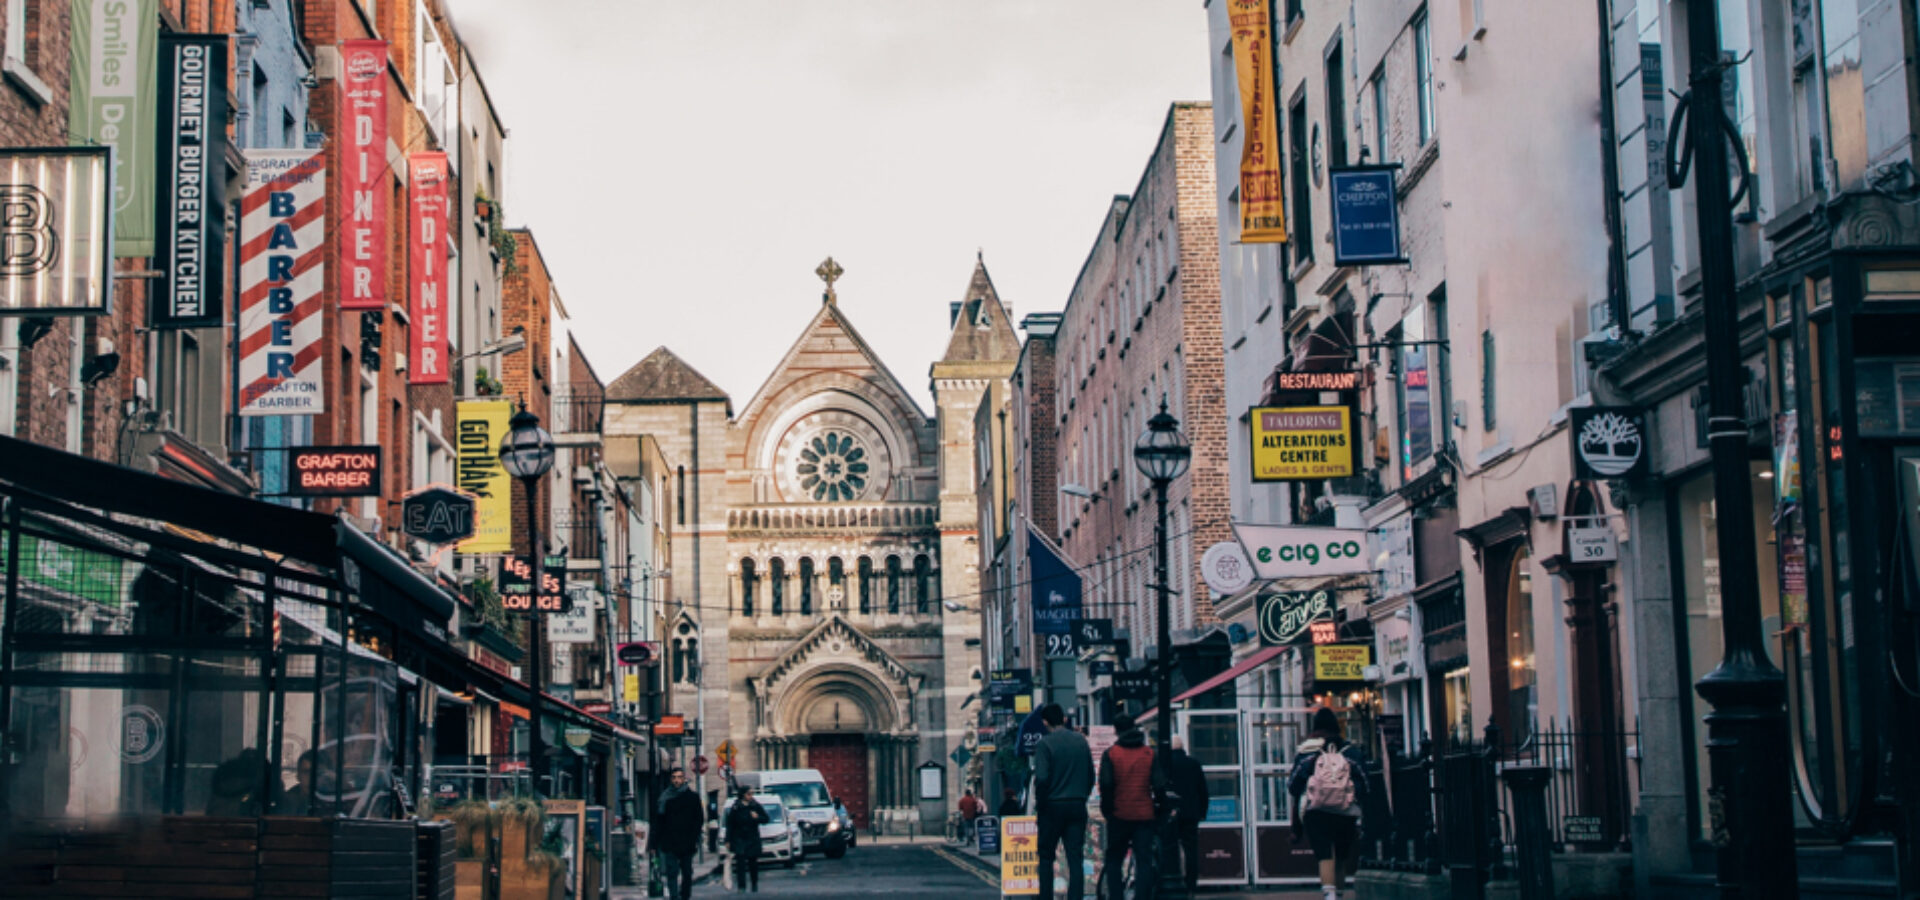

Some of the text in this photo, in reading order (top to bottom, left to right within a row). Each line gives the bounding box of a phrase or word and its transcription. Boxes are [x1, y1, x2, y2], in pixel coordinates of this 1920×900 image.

[102, 1, 127, 87] Smiles
[260, 158, 320, 169] GRAFTON
[176, 45, 203, 317] GOURMET BURGER KITCHEN
[261, 173, 314, 183] BARBER
[353, 115, 373, 298] DINER
[267, 191, 298, 379] BARBER
[421, 217, 437, 375] DINER
[257, 381, 317, 393] GRAFTON
[1280, 373, 1356, 390] RESTAURANT
[258, 396, 312, 409] BARBER
[1269, 415, 1337, 428] TAILORING
[1262, 434, 1346, 448] ALTERATIONS
[296, 453, 376, 470] GRAFTON
[1280, 450, 1328, 463] CENTRE
[1262, 466, 1298, 474] LADIES
[1312, 465, 1346, 474] GENTS
[301, 471, 370, 487] BARBER
[407, 500, 469, 534] EAT
[1256, 540, 1360, 565] e cig co
[1584, 546, 1604, 557] 30
[1034, 608, 1080, 620] MAGEE
[1312, 631, 1337, 643] BAR
[1047, 634, 1075, 657] 22
[1005, 851, 1039, 863] ALTERAT
[1013, 865, 1039, 877] CENT
